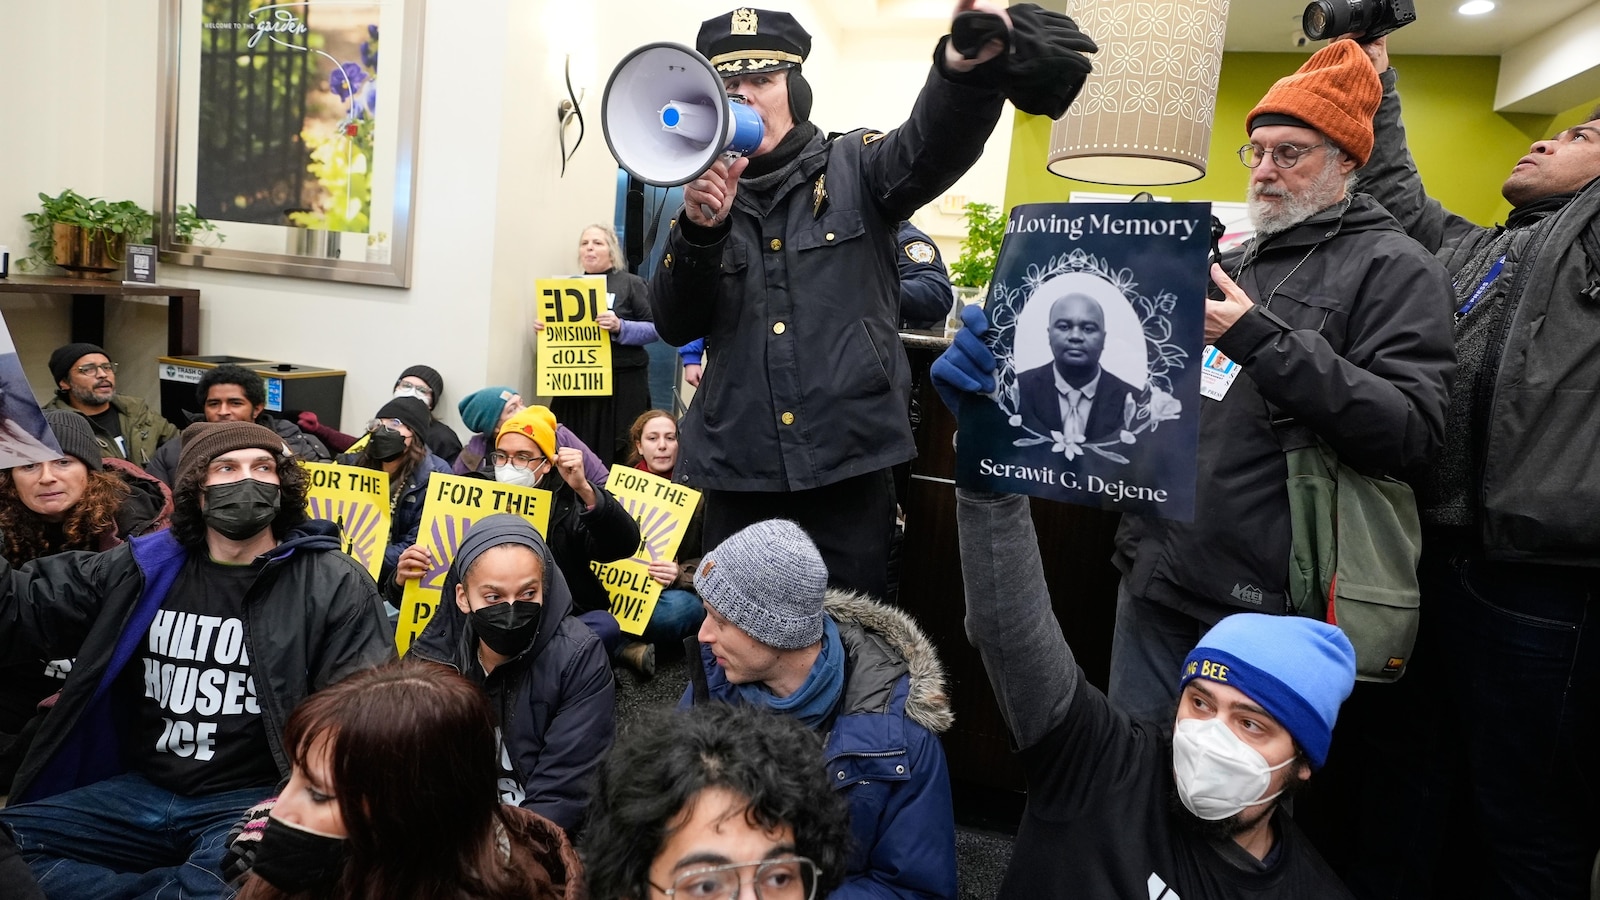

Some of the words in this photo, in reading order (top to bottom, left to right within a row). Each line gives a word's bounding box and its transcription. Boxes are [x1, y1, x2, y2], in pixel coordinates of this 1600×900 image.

[248, 10, 307, 48] garden
[1016, 214, 1085, 241] Loving
[1089, 213, 1199, 241] Memory
[543, 288, 598, 322] ICE
[1469, 281, 1489, 303] PRESS
[546, 326, 601, 341] HOUSING
[552, 349, 597, 364] STOP
[546, 373, 603, 390] HILTON:
[307, 469, 341, 489] OR
[348, 473, 380, 495] THE
[614, 472, 649, 493] FOR
[654, 483, 688, 507] THE
[979, 458, 1056, 485] Serawit
[1060, 471, 1082, 490] G.
[1087, 475, 1168, 503] Dejene
[437, 481, 483, 508] FOR
[492, 490, 537, 516] THE
[610, 593, 647, 622] OVE
[1201, 660, 1230, 681] BEE
[155, 717, 218, 762] ICE
